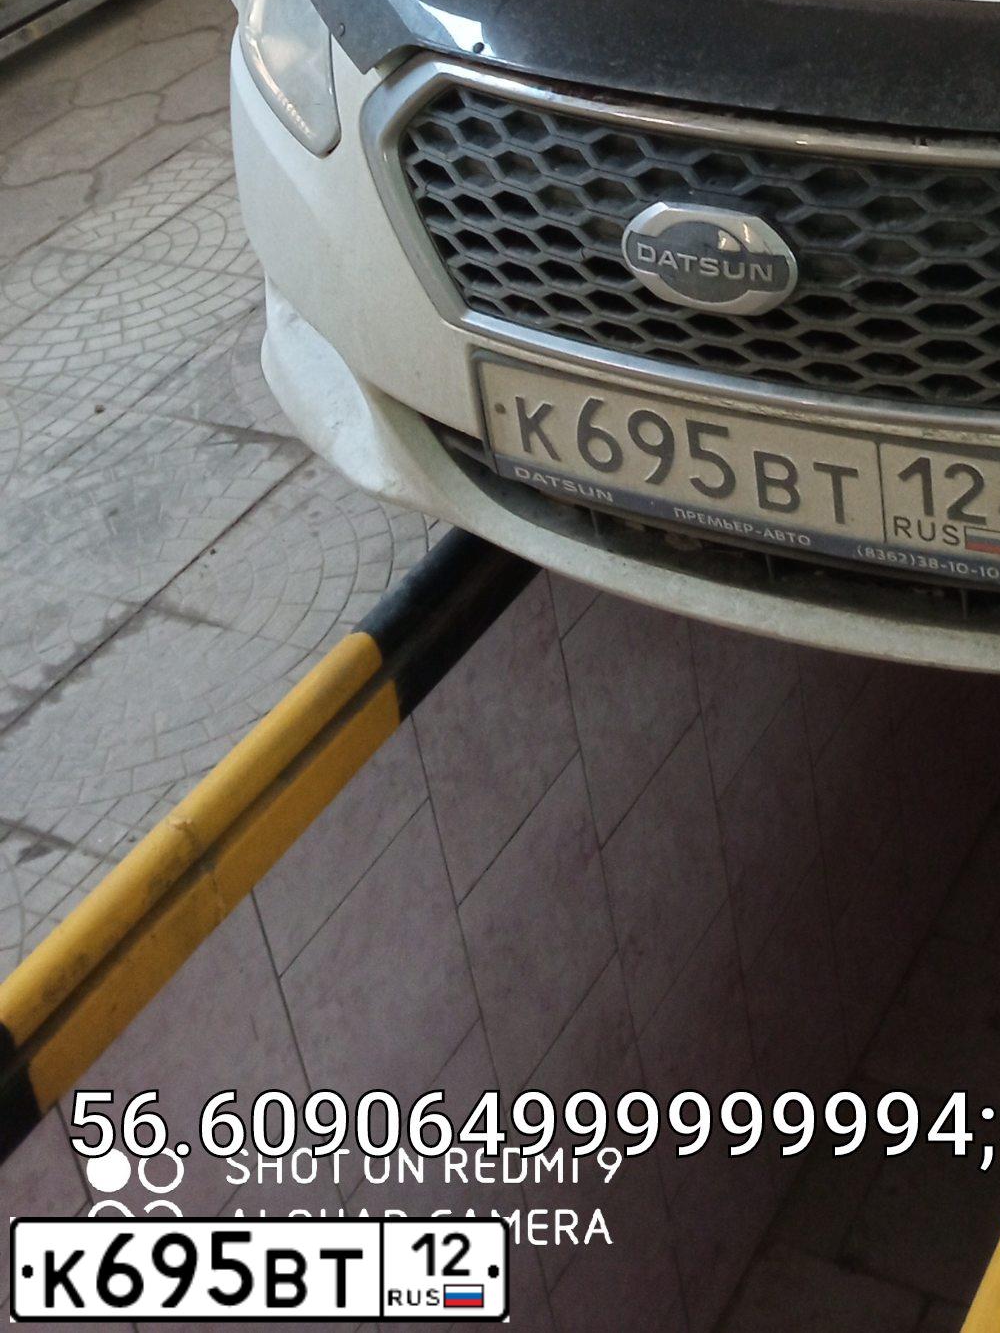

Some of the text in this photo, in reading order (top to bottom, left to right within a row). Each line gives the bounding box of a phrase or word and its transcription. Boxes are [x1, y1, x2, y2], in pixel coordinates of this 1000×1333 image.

[636, 242, 774, 283] DATSUN
[514, 467, 614, 503] DATSUN
[897, 456, 987, 525] 12
[673, 507, 811, 546] ПРЕМЬЕР-АВТО
[893, 516, 961, 547] RUS
